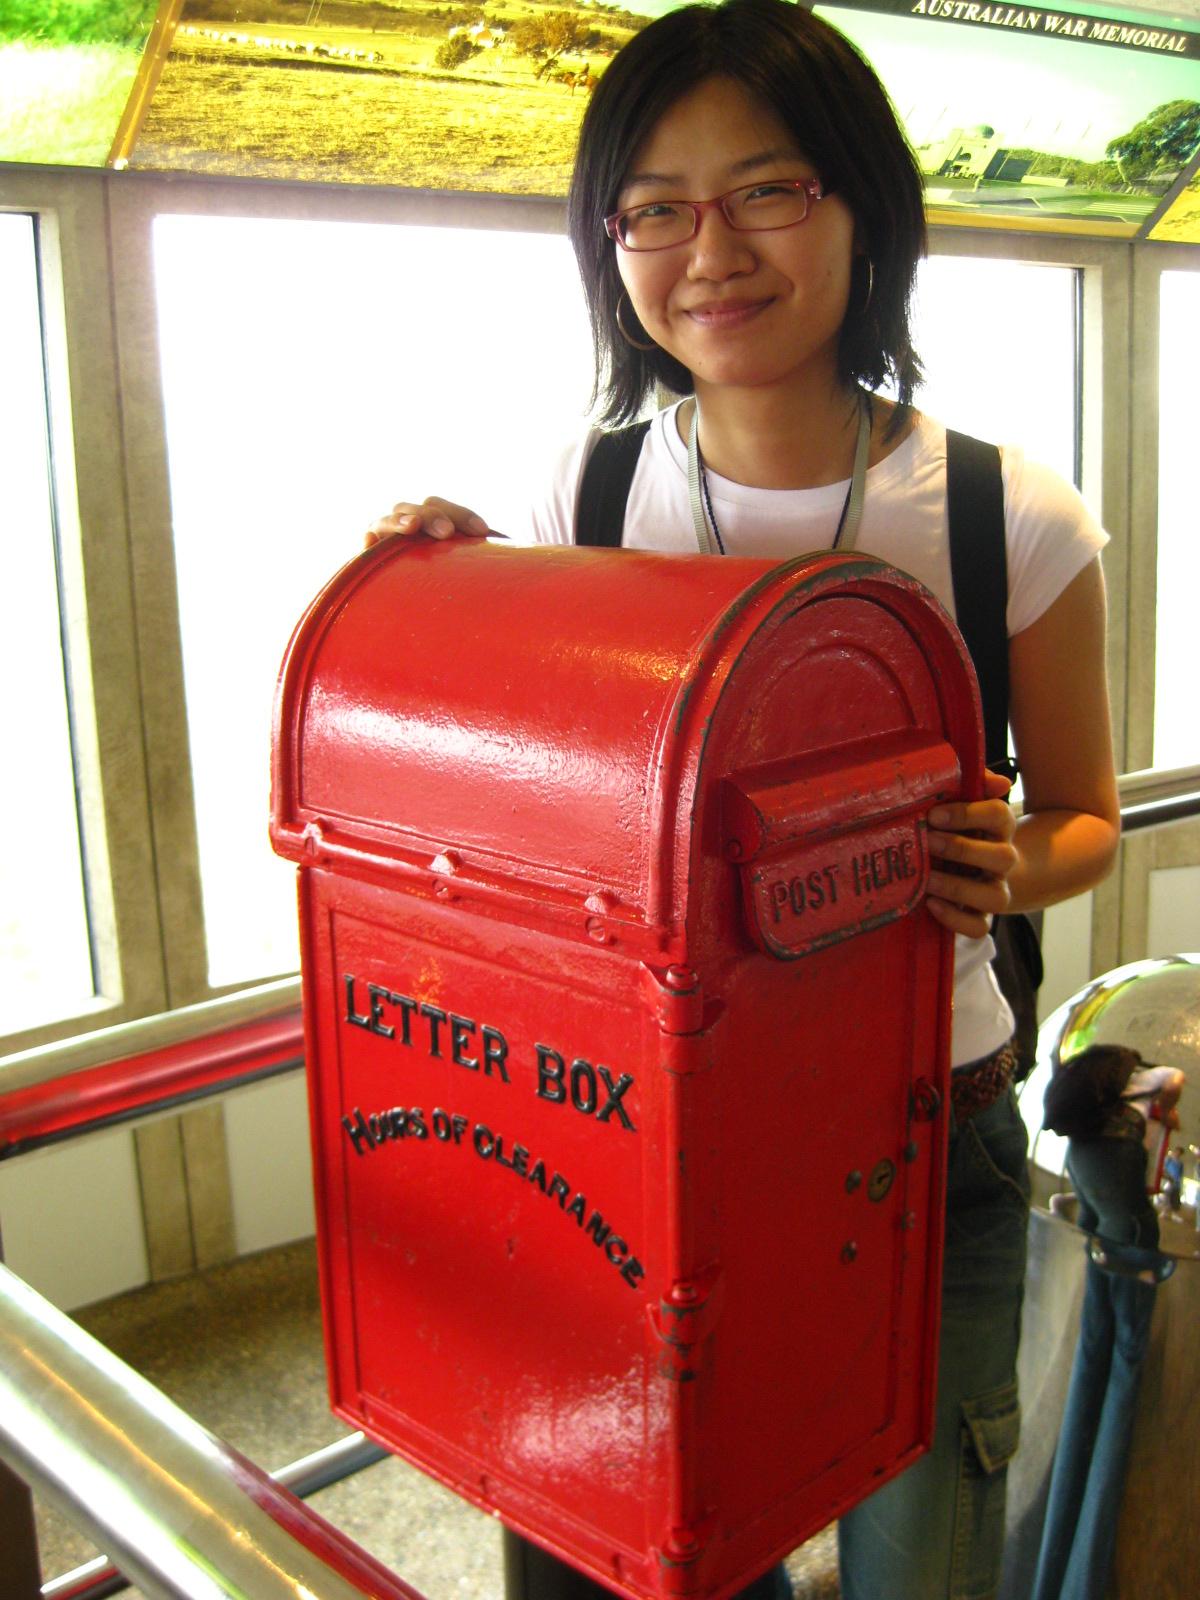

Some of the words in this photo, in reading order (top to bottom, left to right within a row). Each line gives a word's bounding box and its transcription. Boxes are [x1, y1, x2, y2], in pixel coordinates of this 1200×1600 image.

[911, 0, 1041, 29] AUSTRALIAN
[1044, 15, 1086, 37] WAR
[1088, 22, 1187, 53] MEMORIAL
[771, 864, 839, 923] POST
[853, 839, 917, 896] HERE
[344, 973, 511, 1084] LETTER
[534, 1042, 637, 1132] BOX
[432, 1107, 468, 1144] OF
[473, 1124, 645, 1290] CLEARANCE
